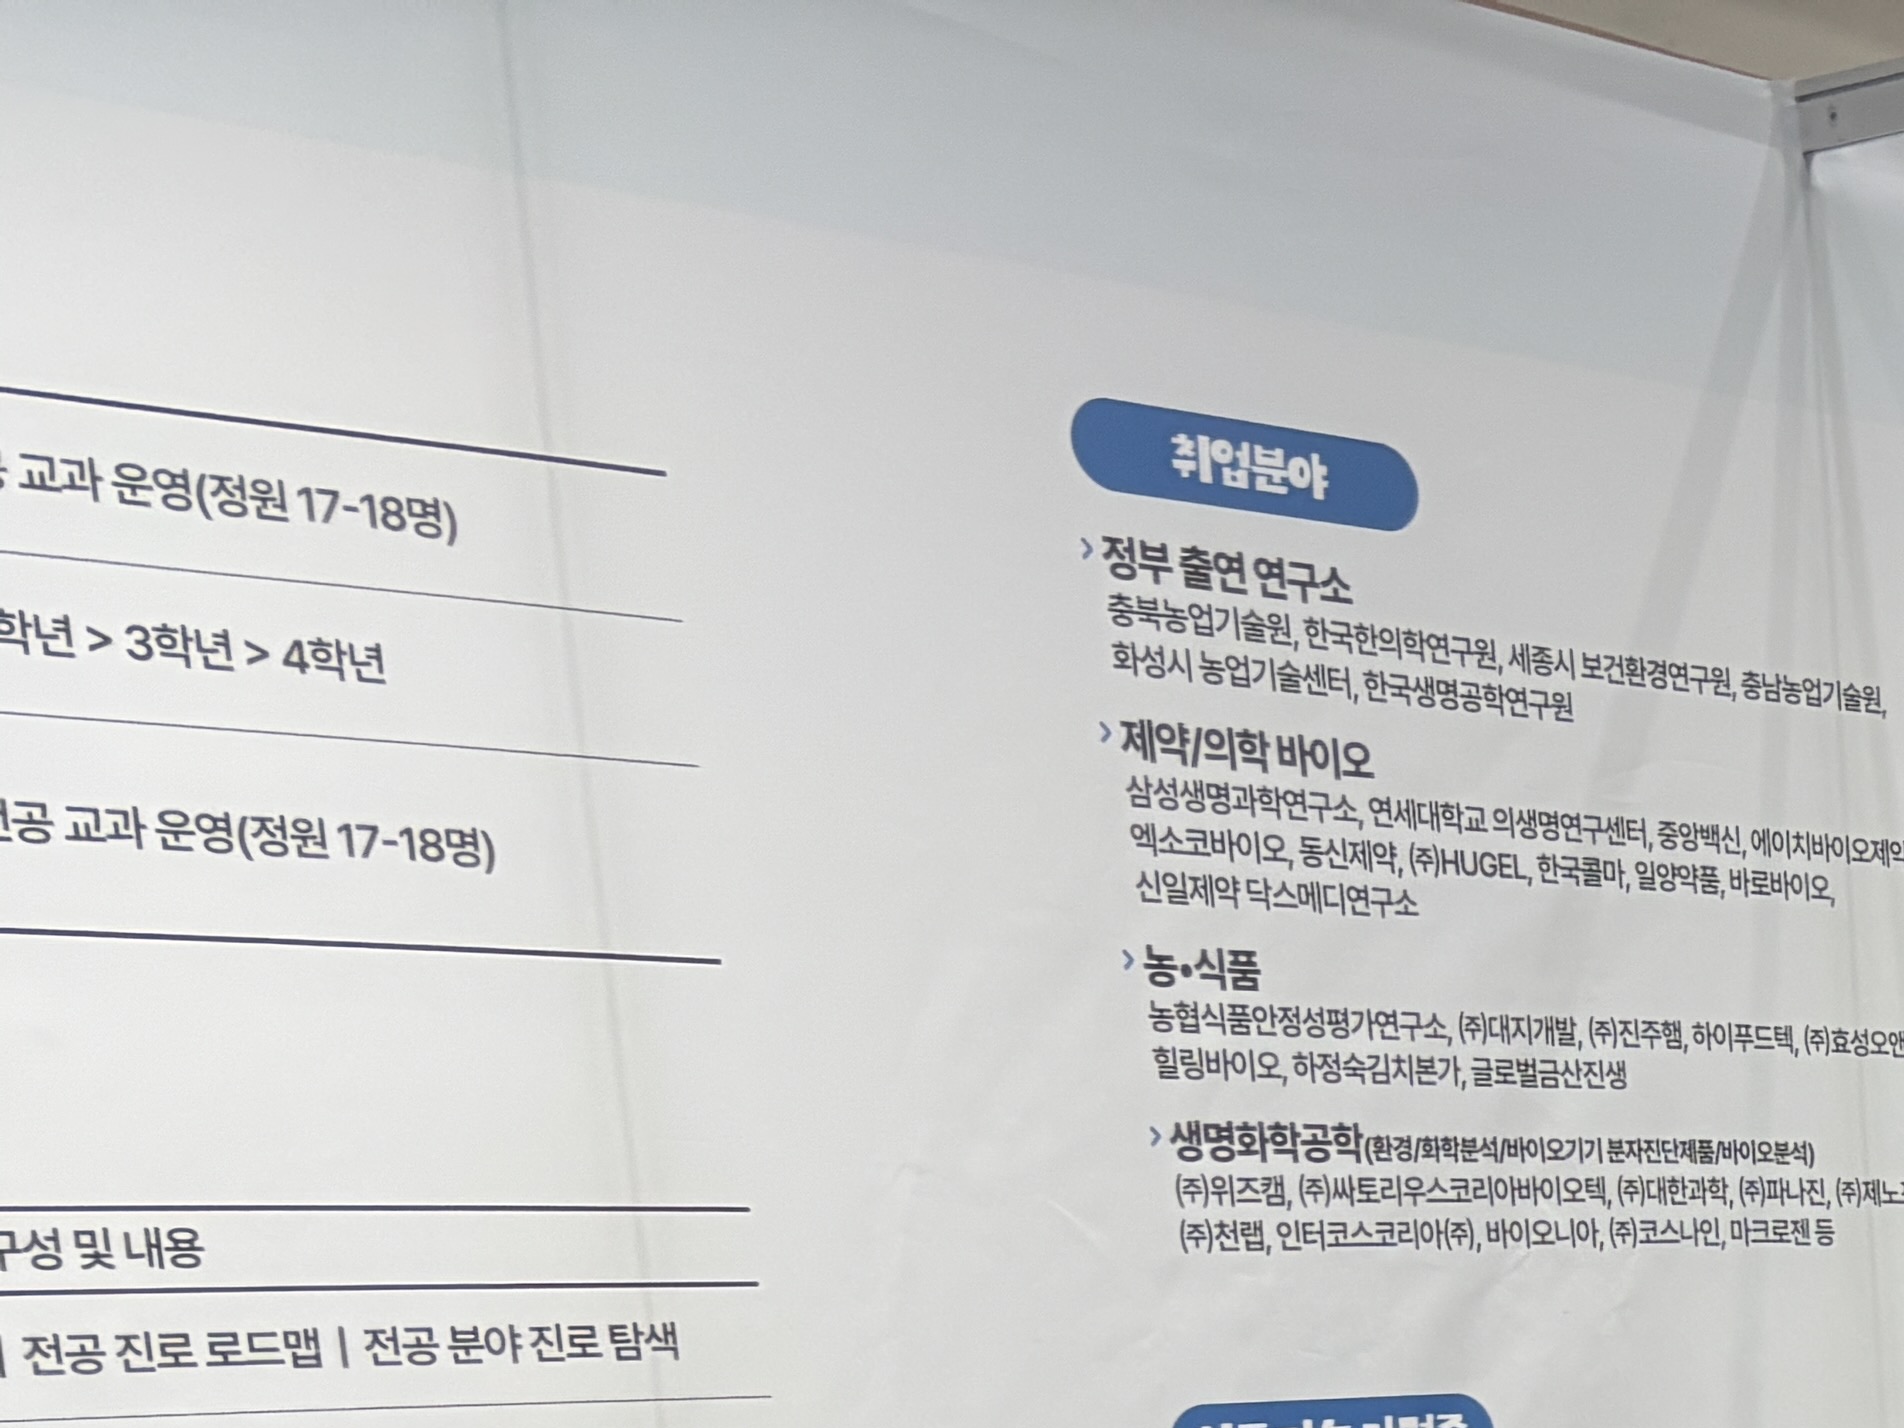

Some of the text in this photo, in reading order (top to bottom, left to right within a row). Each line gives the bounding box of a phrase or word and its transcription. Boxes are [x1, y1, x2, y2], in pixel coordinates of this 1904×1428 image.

[1171, 434, 1328, 499] 취업분야
[19, 453, 104, 502] 교과
[111, 463, 289, 522] 운영(정원
[297, 487, 457, 546] 17-18명)
[1102, 536, 1353, 604] 정부 출연 연구소
[125, 623, 234, 671] 3학년
[283, 637, 386, 684] 4학년
[1107, 592, 1886, 719] 충북농업기술원, 한국한의학연구원, 세종시 보건환경연구원, 충남농업기술원,
[1112, 641, 1575, 722] 화성시 농업기술센터, 한국생명공학연구원
[1120, 719, 1375, 780] 제약/의학 바이오
[65, 806, 495, 874] 교과 운영(정원 17-18명)
[1126, 775, 1363, 835] 삼성생명과학연구소,
[1369, 796, 1488, 834] 연세대학교
[1657, 821, 1746, 859] 중앙백신,
[1136, 870, 1419, 918] 신일제약 닥스메디연구소
[1299, 836, 1403, 878] 동신제약,
[1536, 853, 1630, 893] 한국콜마,
[1635, 861, 1725, 899] 일양약품,
[1729, 868, 1835, 907] 바로바이오,
[1152, 1046, 1287, 1087] 힐링바이오,
[74, 1227, 115, 1269] 및
[124, 1227, 205, 1269] 내용
[1486, 1218, 1604, 1251] 바이오니아,
[1730, 1217, 1811, 1247] 마크로젠
[1815, 1219, 1835, 1246] 등
[22, 1322, 679, 1376] 전공 진로 로드맵 전공 분야 진로 탐색
